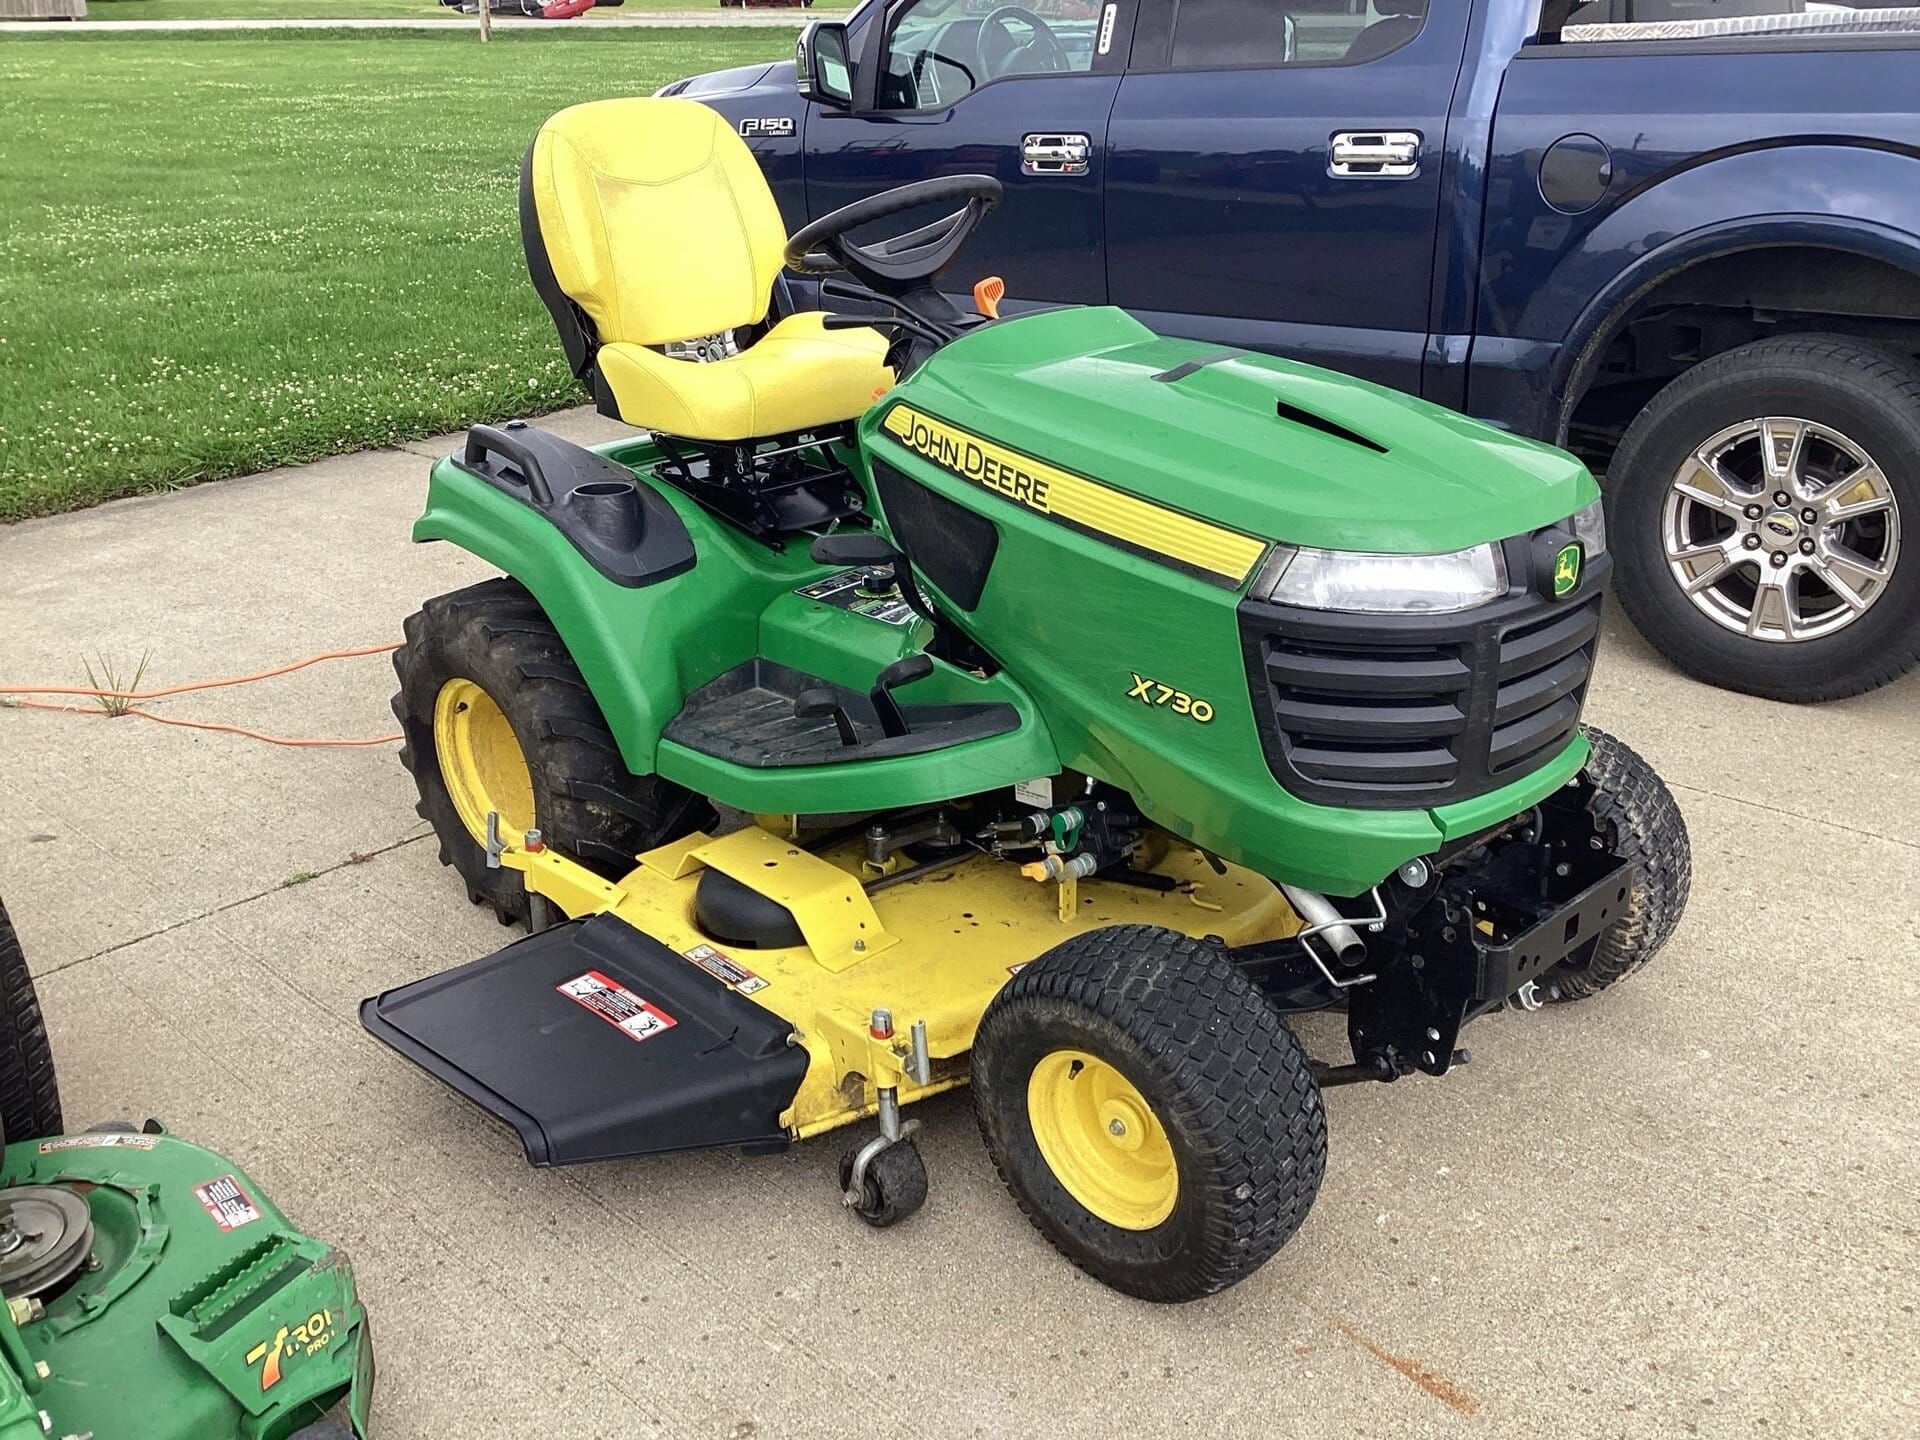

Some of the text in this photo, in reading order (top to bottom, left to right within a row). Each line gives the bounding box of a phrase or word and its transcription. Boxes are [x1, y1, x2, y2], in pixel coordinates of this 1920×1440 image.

[901, 413, 1051, 509] JOHN DEERE
[1125, 672, 1215, 723] X730
[306, 1333, 330, 1357] PRO
